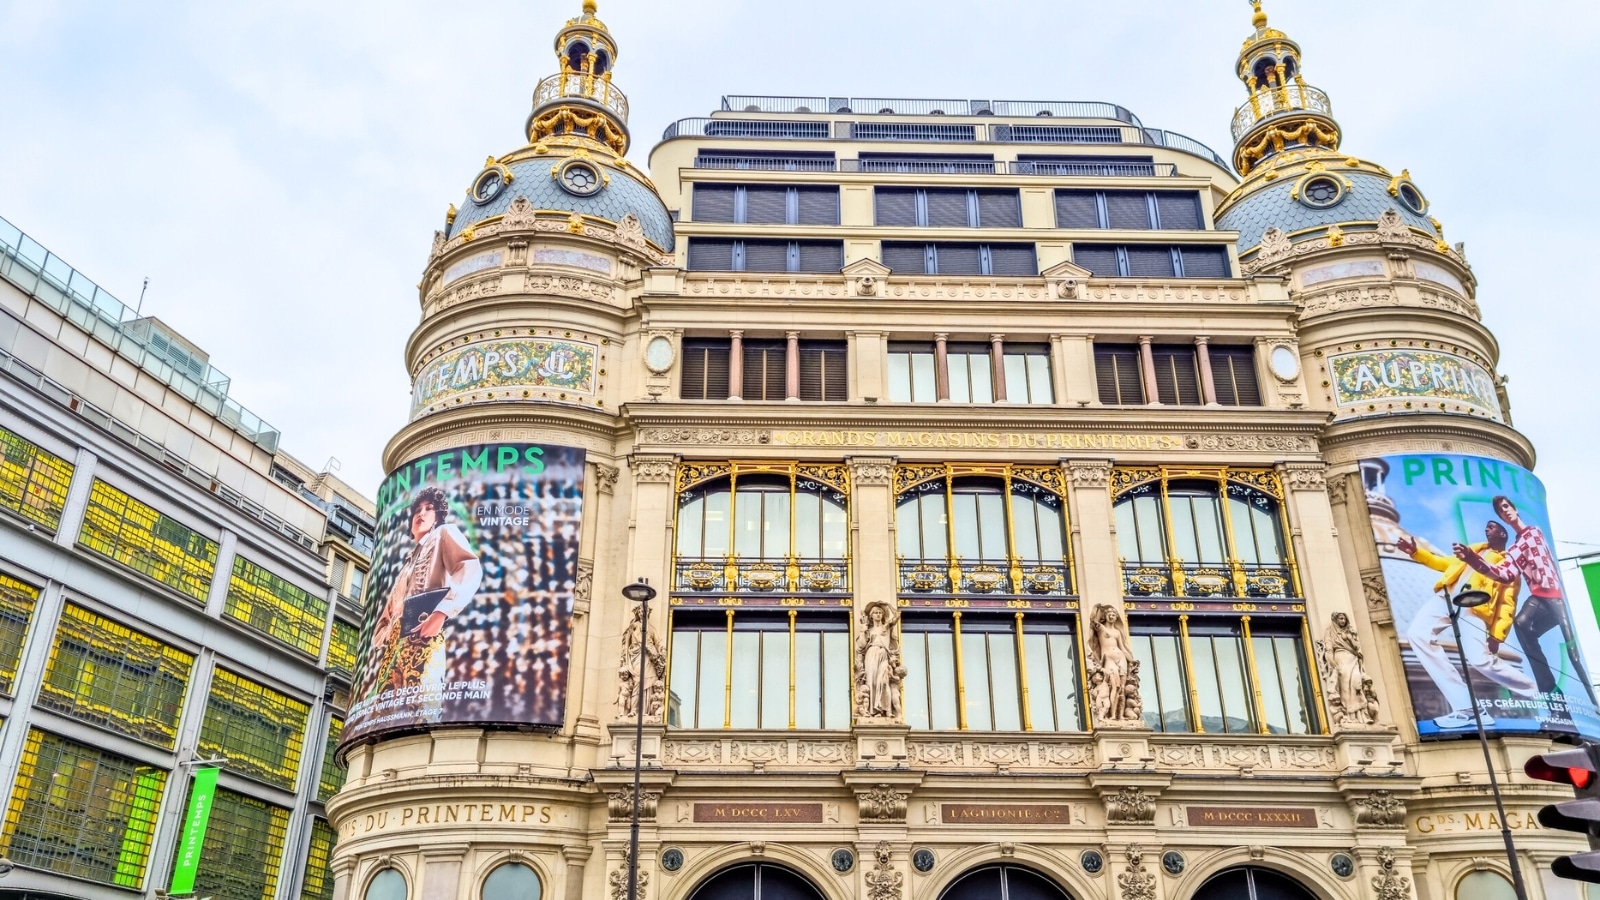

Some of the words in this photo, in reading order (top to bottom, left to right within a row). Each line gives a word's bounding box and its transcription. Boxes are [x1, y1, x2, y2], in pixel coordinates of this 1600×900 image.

[1355, 361, 1401, 392] AU
[785, 430, 877, 446] GRANDS
[886, 431, 999, 447] MAGASINS
[1008, 433, 1037, 448] DU
[1046, 433, 1172, 449] PRINTEMPS
[477, 506, 492, 516] EN
[495, 505, 530, 516] MODE
[480, 516, 529, 526] VINTAGE
[448, 681, 459, 690] LE
[461, 680, 486, 690] PLUS
[405, 695, 416, 704] ET
[464, 690, 491, 700] MAIN
[1494, 697, 1549, 710] CRÉATEURS
[1549, 701, 1565, 712] LES
[365, 811, 388, 832] DU
[401, 804, 552, 827] PRINTEMPS
[715, 808, 726, 817] M
[732, 808, 768, 817] DCCC
[775, 808, 802, 817] LXV
[1204, 812, 1214, 820] M
[1219, 812, 1252, 820] DCCC
[1463, 811, 1541, 831] MAGA
[183, 794, 206, 867] PRINTEMPS
